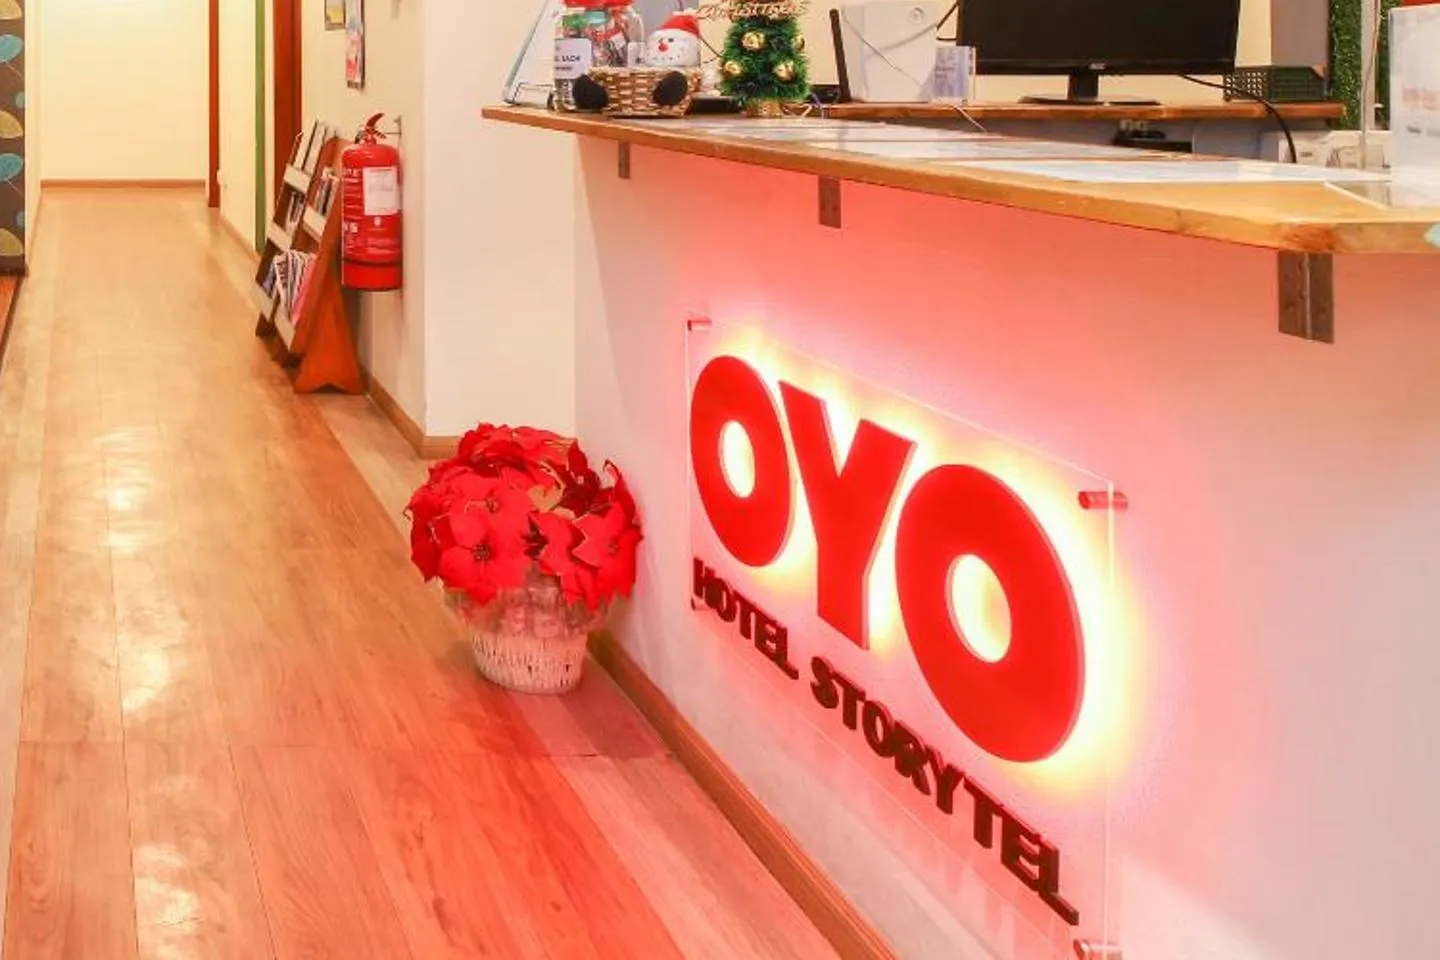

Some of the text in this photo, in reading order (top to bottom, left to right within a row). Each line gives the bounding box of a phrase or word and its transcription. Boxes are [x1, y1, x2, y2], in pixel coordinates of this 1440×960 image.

[690, 355, 1087, 764] OYO
[693, 557, 1079, 926] HOTEL STORYTEL
